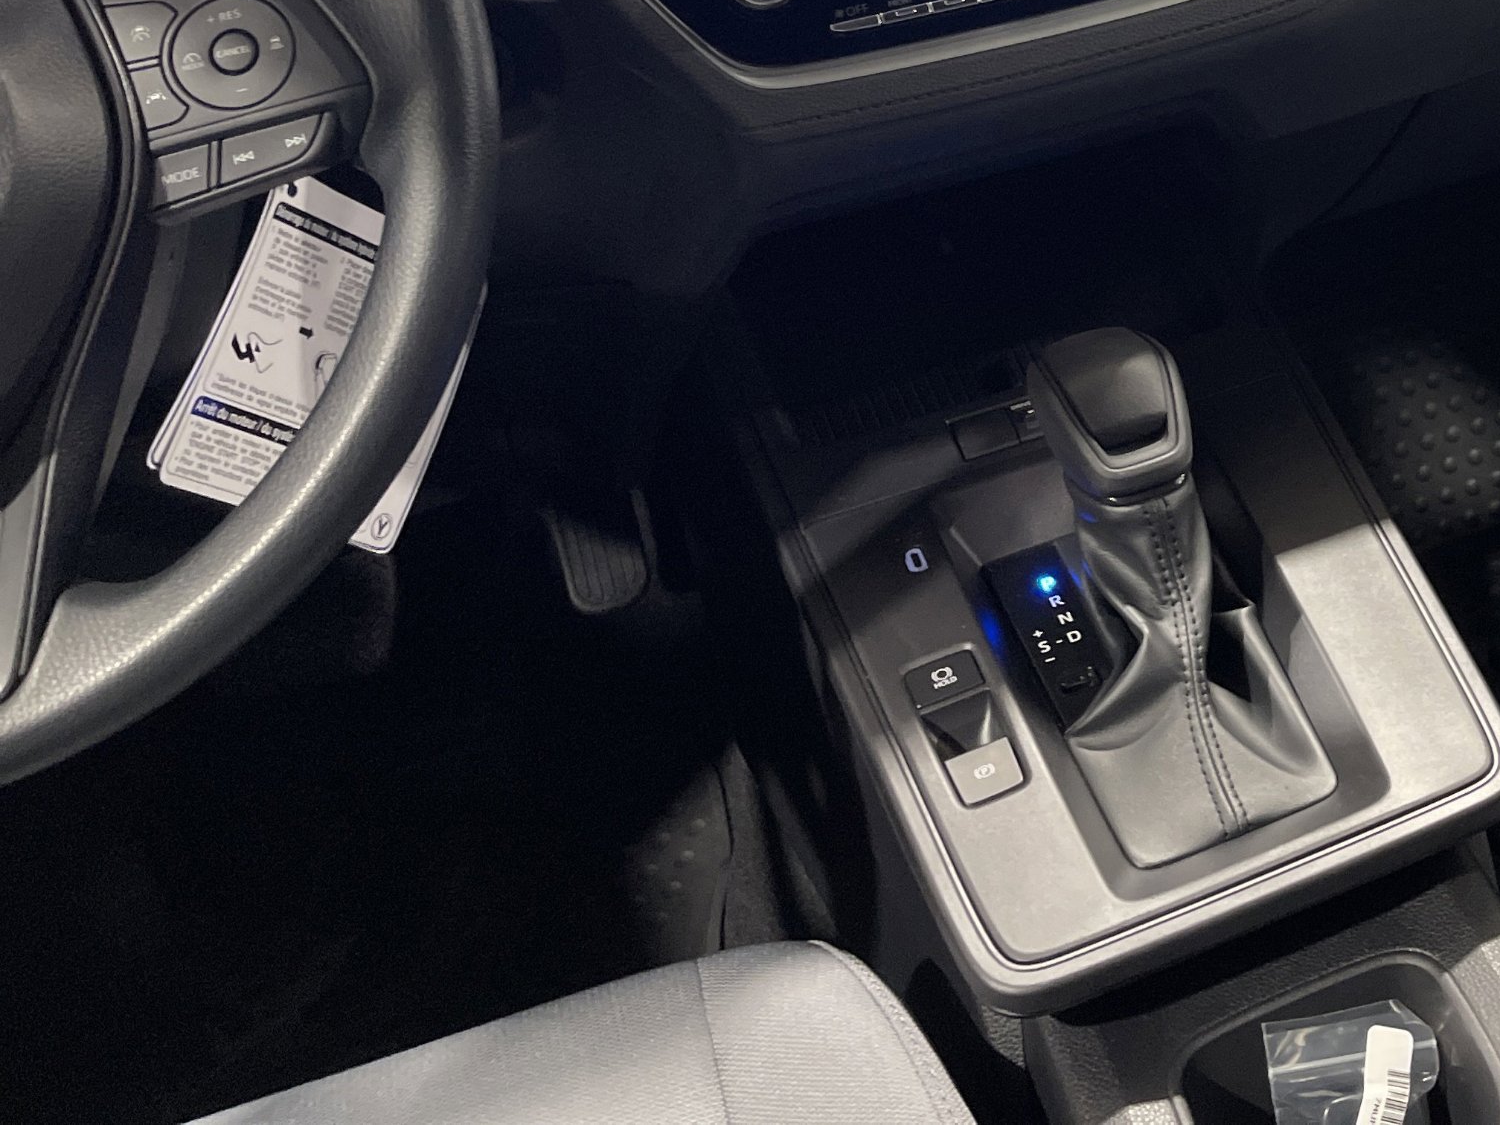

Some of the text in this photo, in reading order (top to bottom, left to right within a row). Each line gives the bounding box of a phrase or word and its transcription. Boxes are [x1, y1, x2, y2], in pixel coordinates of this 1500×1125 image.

[218, 8, 242, 23] RES
[845, 3, 868, 16] OFF
[161, 166, 200, 185] MODE
[1049, 595, 1065, 608] R
[1057, 611, 1074, 625] N
[1038, 630, 1082, 654] S D
[933, 676, 958, 690] HOLD
